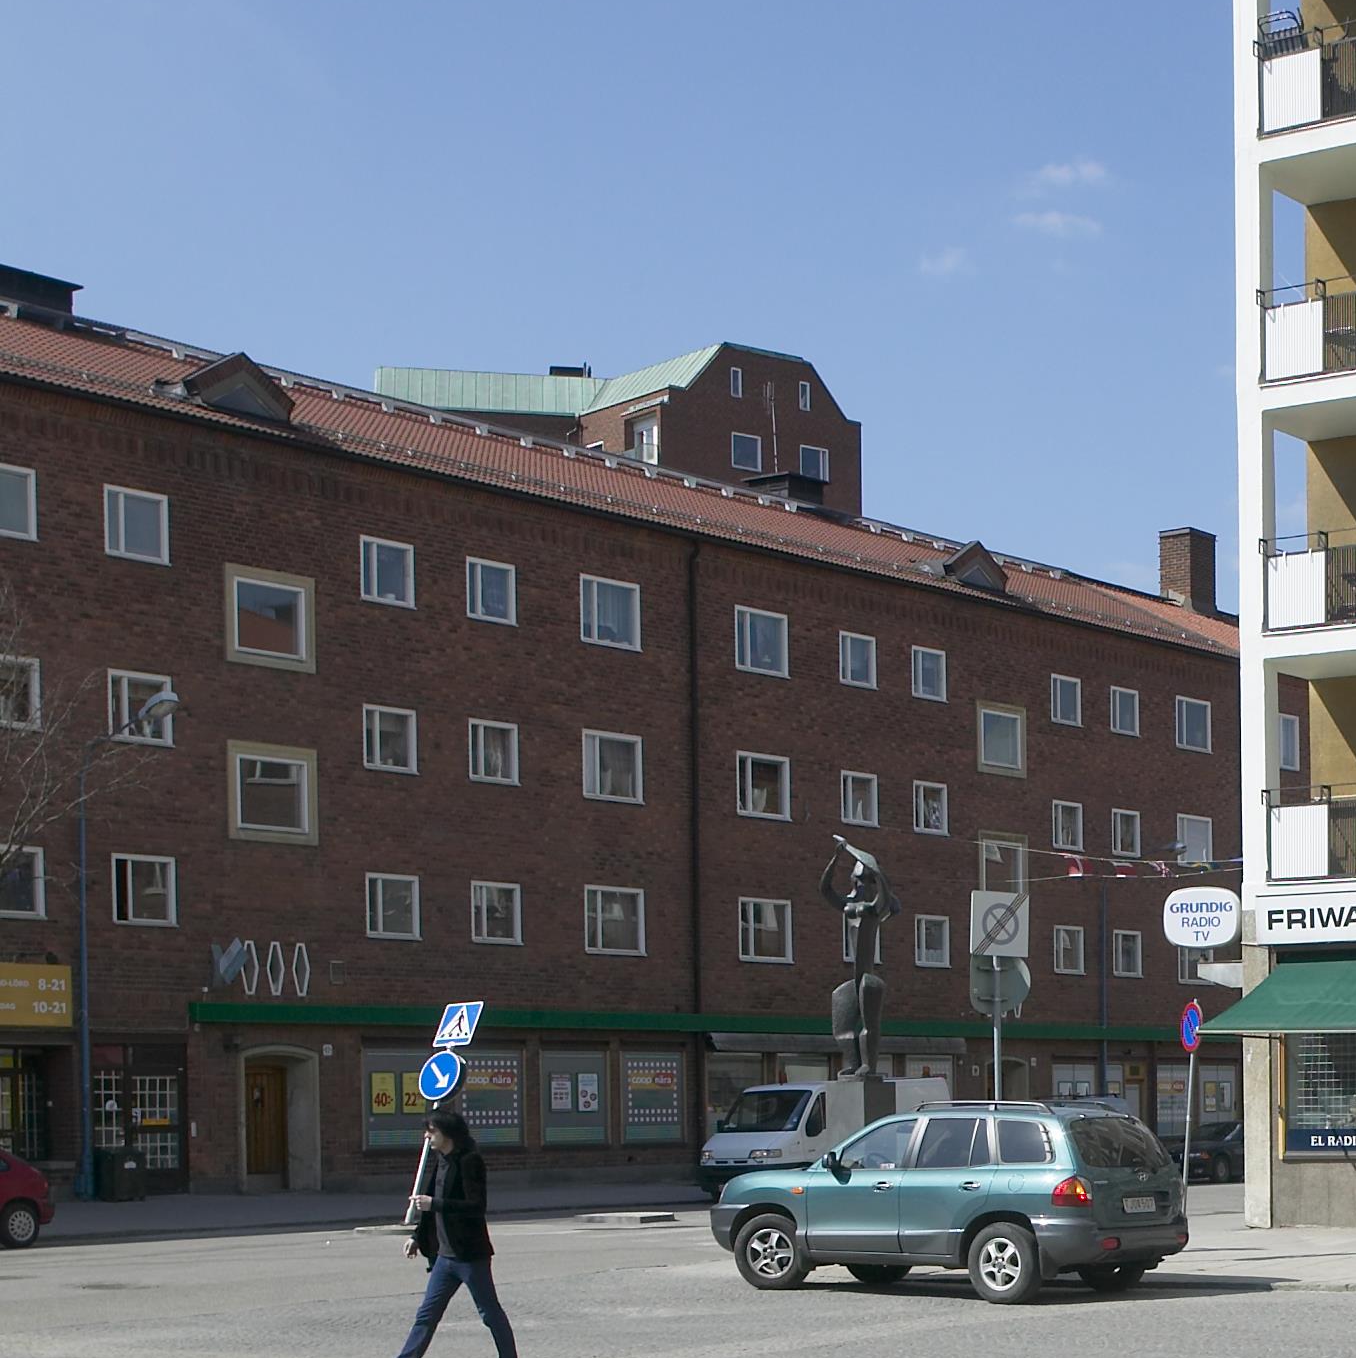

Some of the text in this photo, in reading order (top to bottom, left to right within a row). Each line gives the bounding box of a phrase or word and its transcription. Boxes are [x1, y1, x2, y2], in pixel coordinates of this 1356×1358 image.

[1169, 901, 1233, 914] GRUNDIG
[1181, 916, 1221, 928] RADIO
[1193, 931, 1210, 942] TV
[38, 979, 66, 991] 8-21
[33, 1001, 66, 1014] 10-21
[1310, 1135, 1325, 1147] EL
